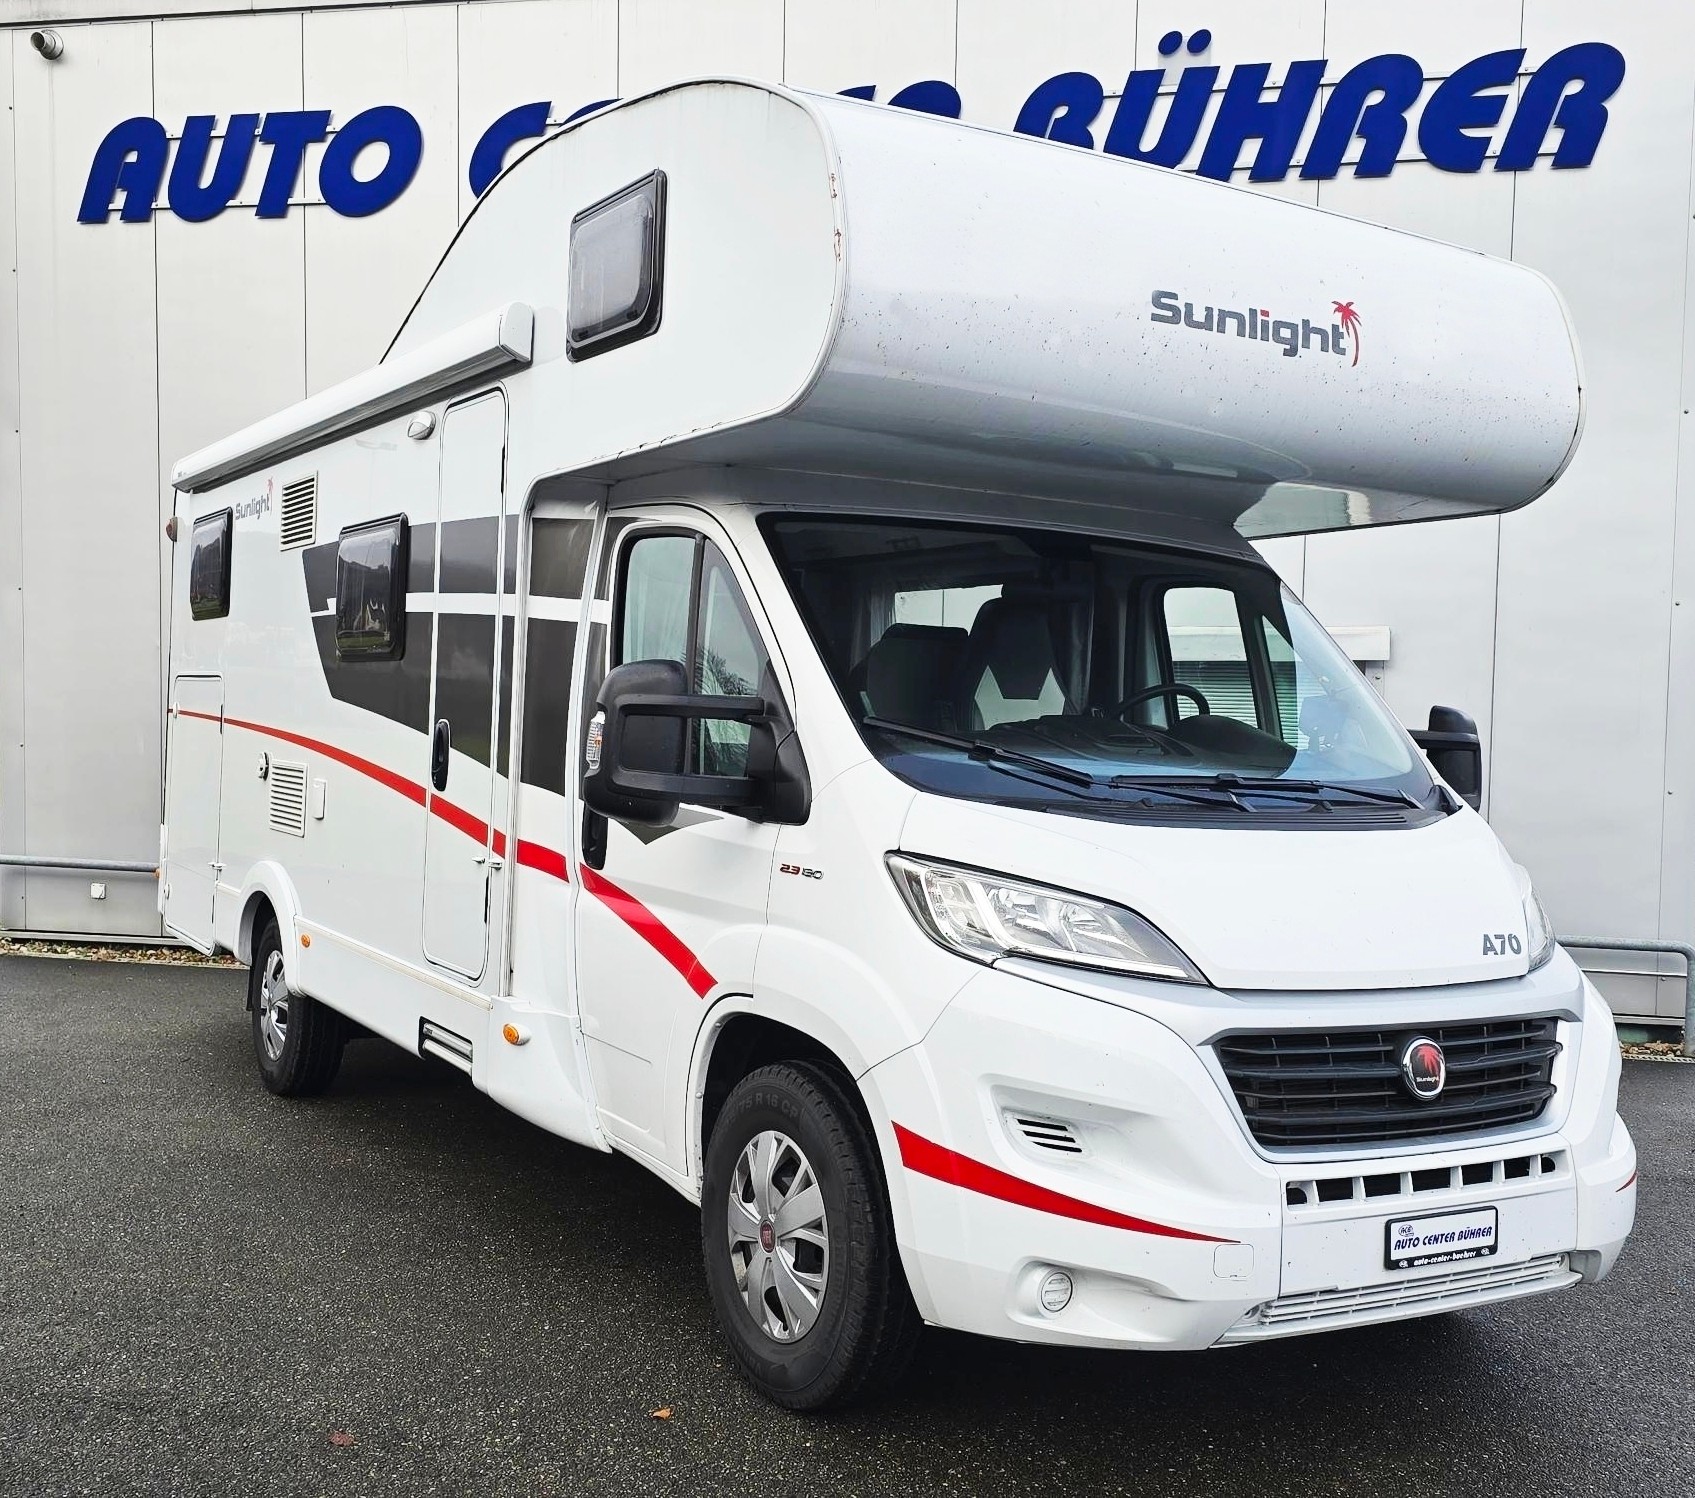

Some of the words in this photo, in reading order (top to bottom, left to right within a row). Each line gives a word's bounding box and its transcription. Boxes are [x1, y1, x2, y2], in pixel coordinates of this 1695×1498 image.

[77, 105, 423, 224] AUTO
[1012, 28, 1626, 182] BÜHRER
[1150, 289, 1347, 357] Sunlight
[235, 493, 270, 520] Sunlight
[1482, 933, 1522, 956] A70
[1394, 1236, 1420, 1250] AUTO
[1422, 1231, 1456, 1246] CENTER
[1457, 1226, 1493, 1242] BÜHRER
